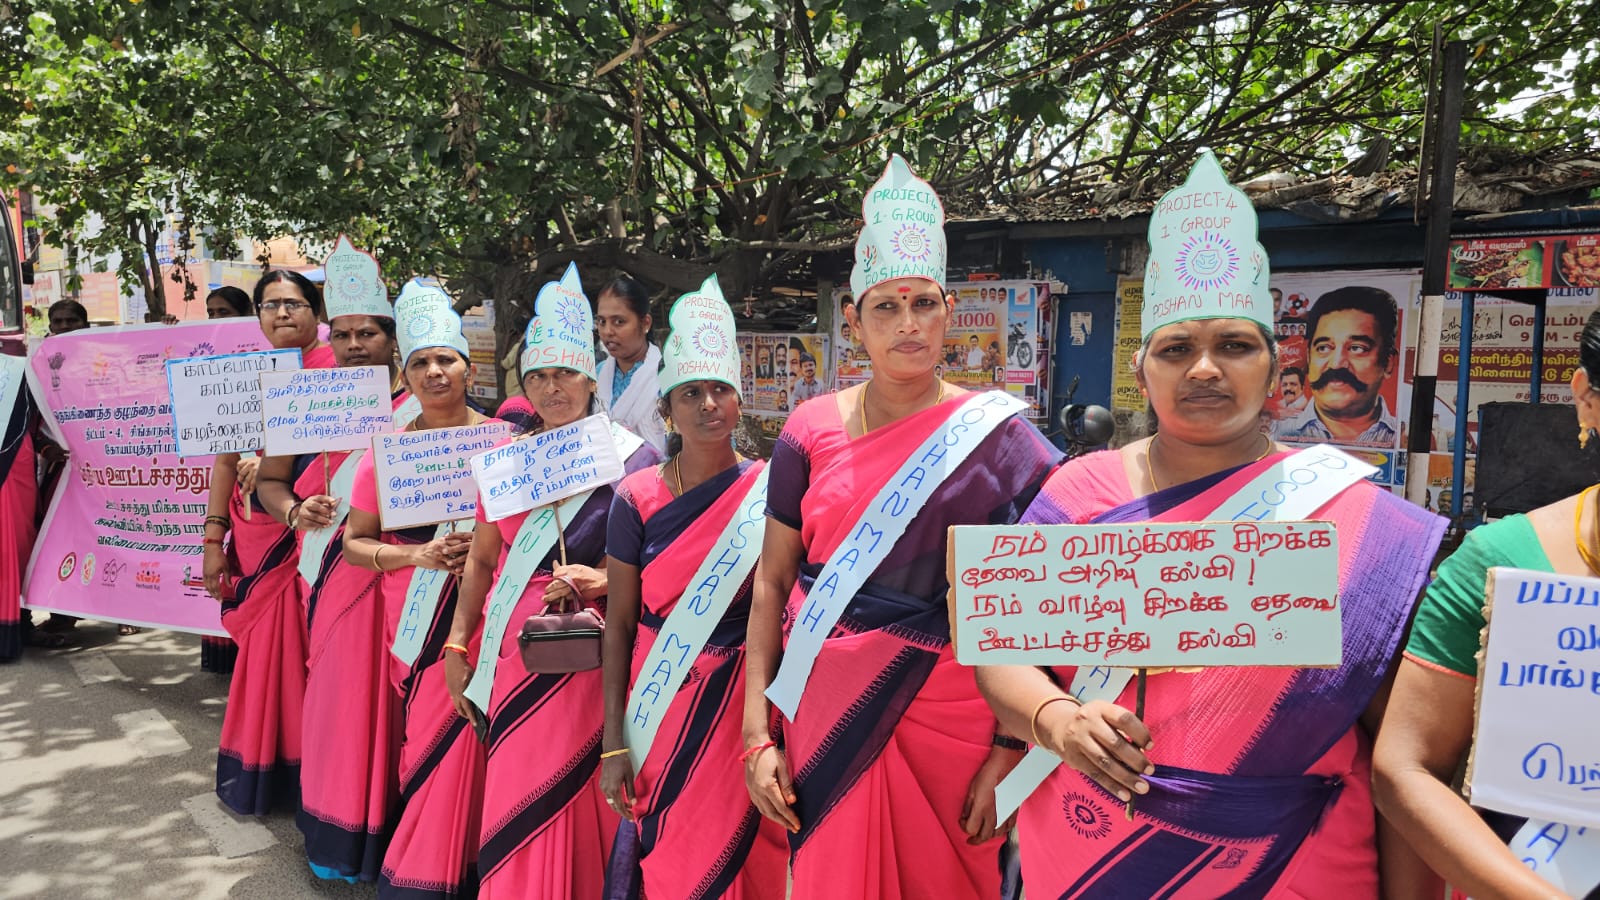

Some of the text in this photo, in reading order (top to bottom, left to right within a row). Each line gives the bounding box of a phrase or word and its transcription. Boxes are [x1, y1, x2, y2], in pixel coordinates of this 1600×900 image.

[892, 207, 936, 226] GROUP
[1181, 216, 1232, 234] GROUP
[1152, 294, 1203, 322] POSHAN
[1218, 291, 1254, 311] MAA
[677, 360, 720, 376] POSHAN
[288, 400, 298, 414] 6
[881, 394, 1009, 518] POSHAN
[106, 457, 212, 495] ஊட்டச்சத்து
[983, 524, 1332, 565] நம் வாழ்க்கை சிறக்க
[802, 521, 884, 634] MAAH
[960, 563, 1047, 589] தேவை
[1057, 560, 1139, 589] அறிவு
[965, 592, 1023, 622] நம்
[1038, 594, 1127, 625] வாழ்வு
[1144, 588, 1229, 617] சிறக்க
[977, 623, 1257, 660] ஊட்டச்சத்து கல்வி
[633, 632, 692, 730] MAAH
